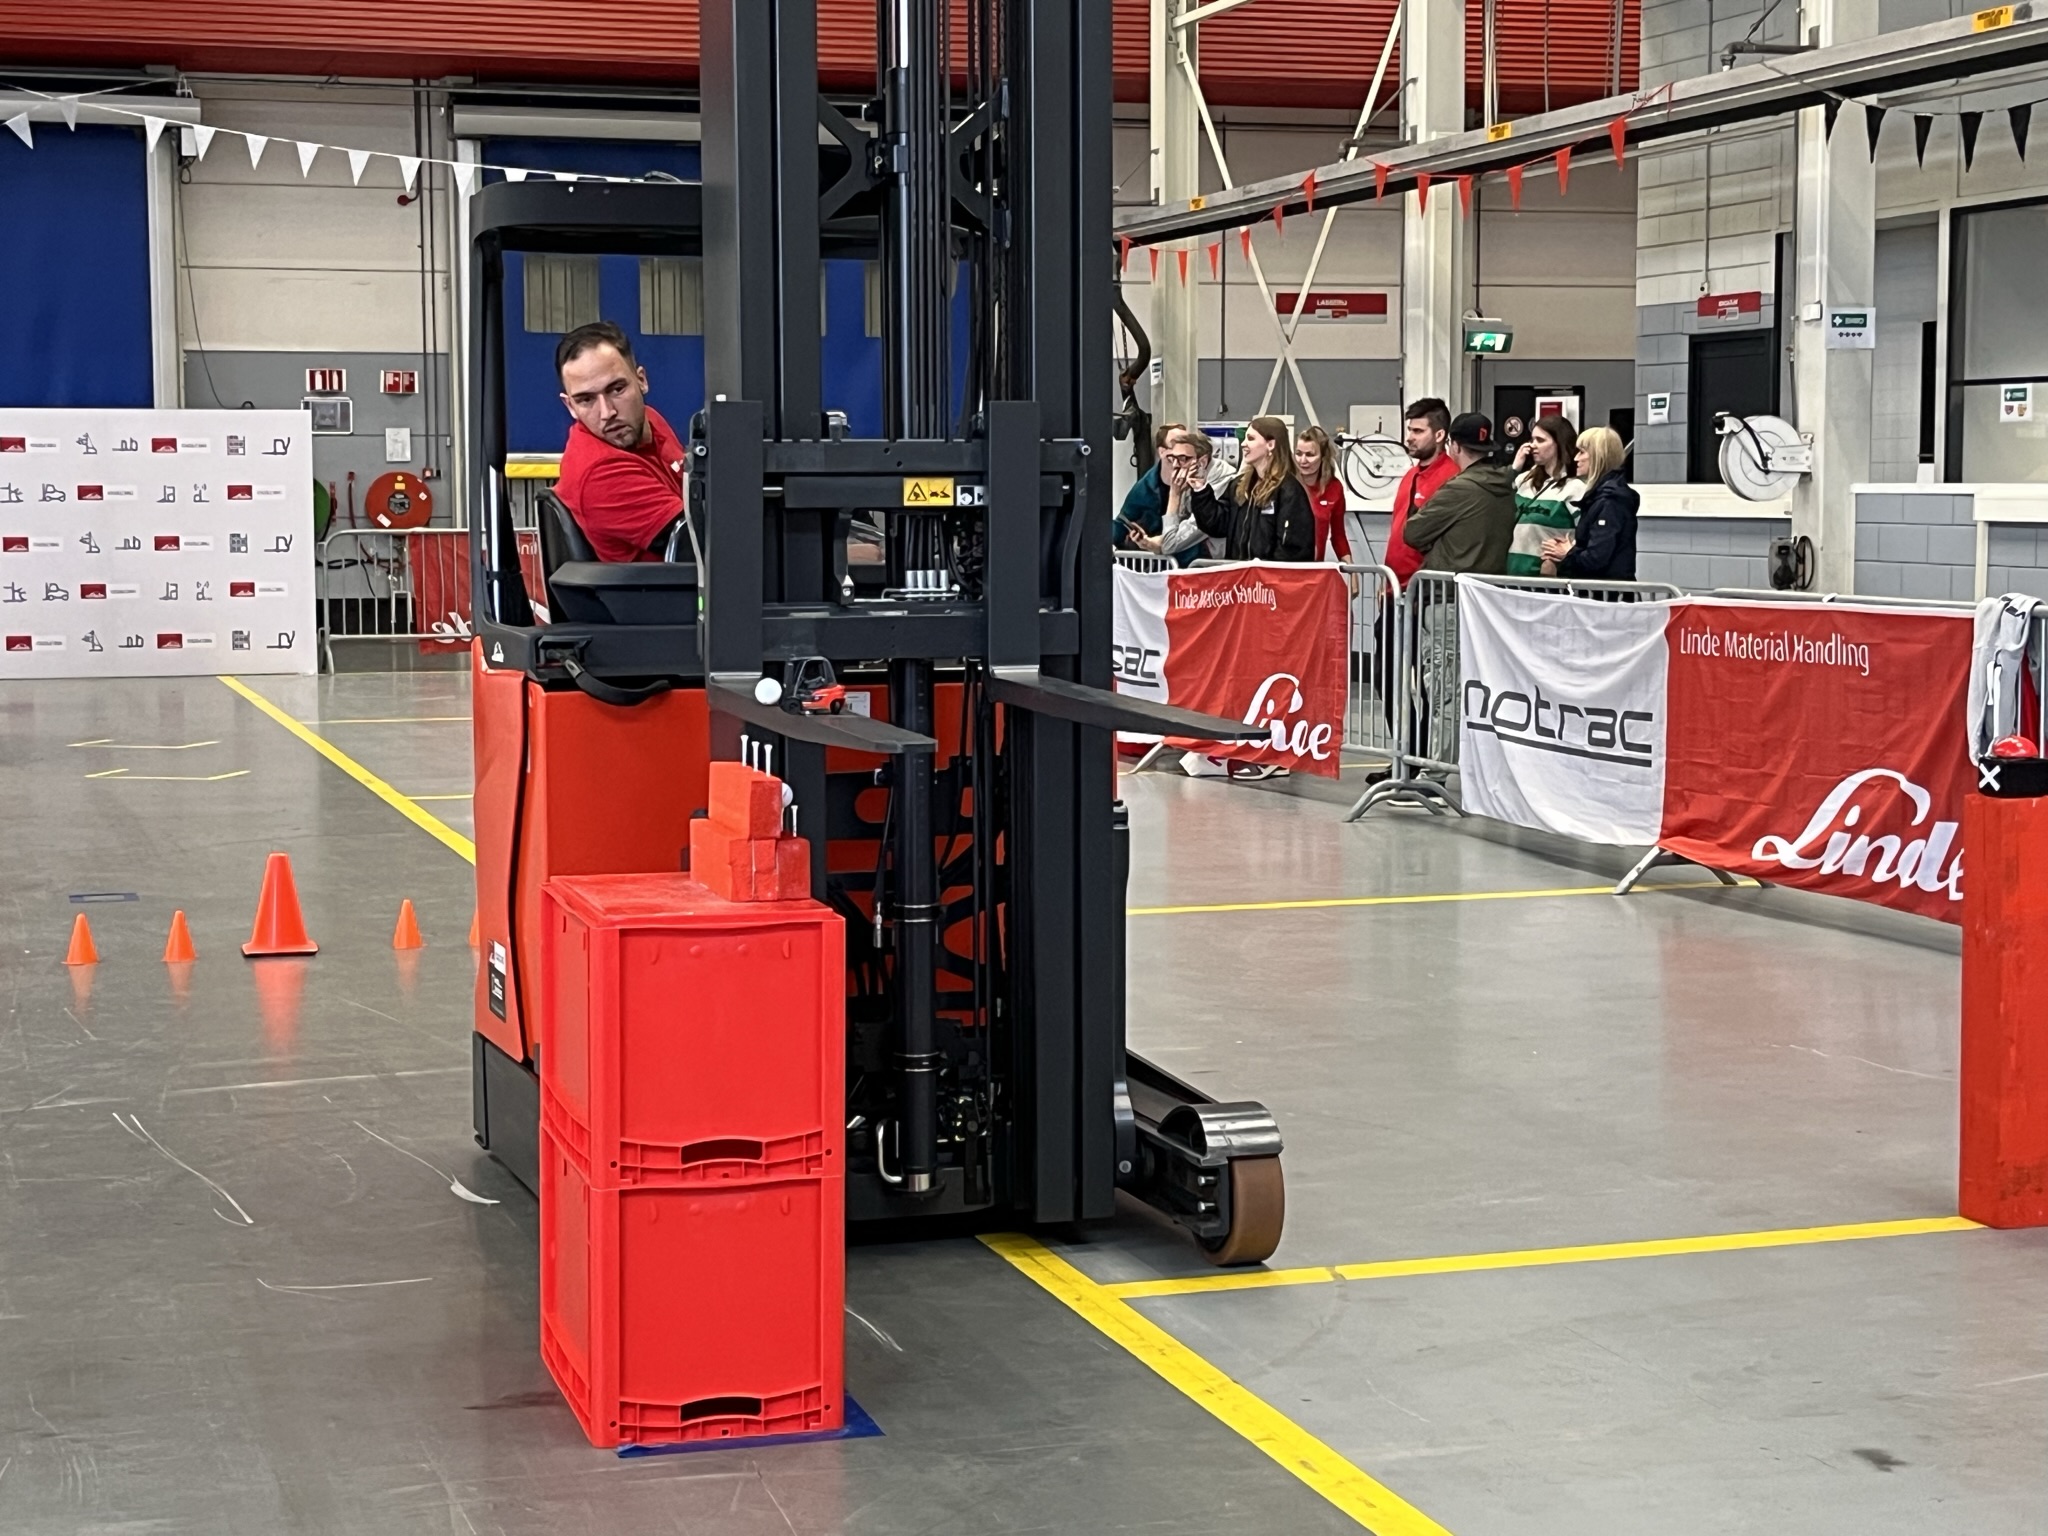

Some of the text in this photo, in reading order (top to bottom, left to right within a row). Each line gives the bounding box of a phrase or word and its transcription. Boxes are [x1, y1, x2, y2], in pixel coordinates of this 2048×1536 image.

[1174, 587, 1198, 609] Linde
[1680, 625, 1870, 676] Linde Material Handling
[1464, 679, 1654, 754] notrac
